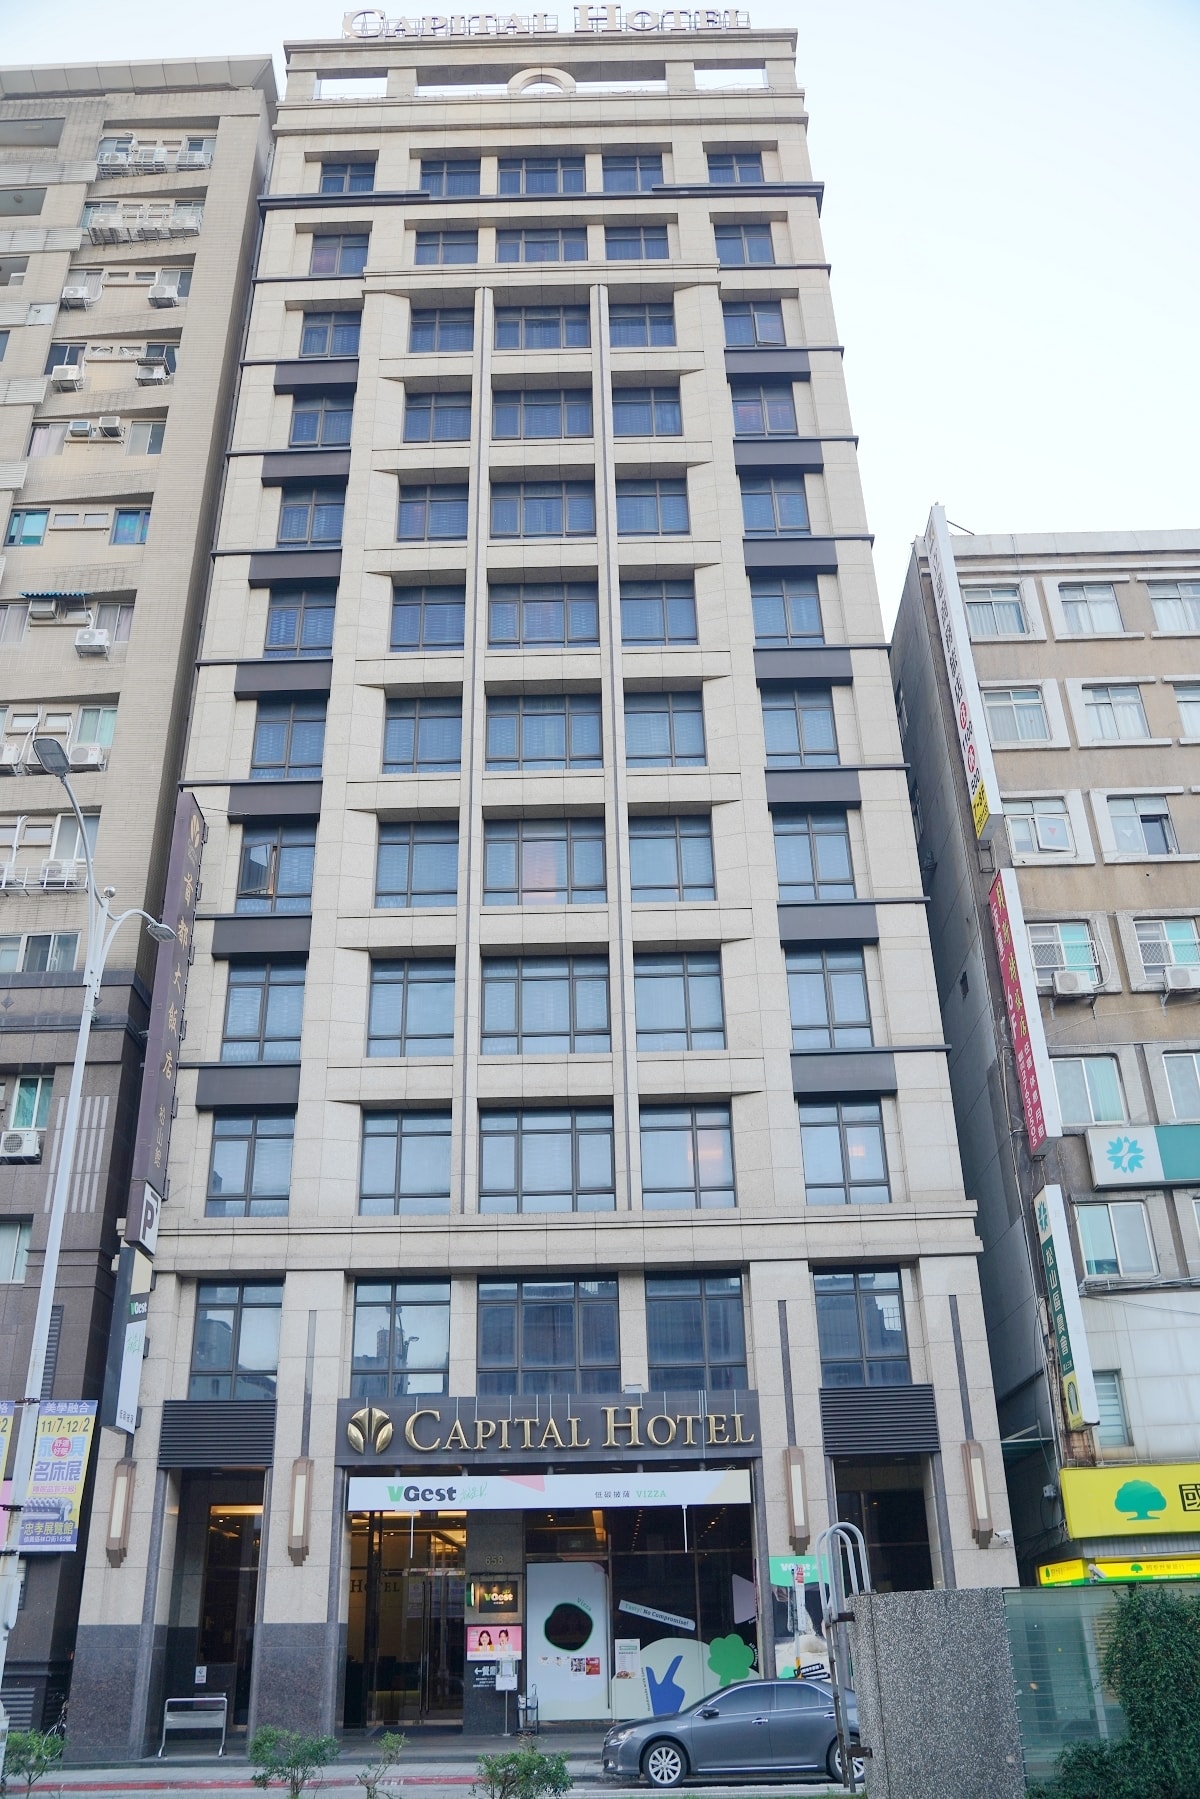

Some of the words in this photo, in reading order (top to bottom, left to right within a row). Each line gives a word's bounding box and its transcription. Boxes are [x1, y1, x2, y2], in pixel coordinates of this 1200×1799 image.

[342, 9, 558, 38] CAPITAL
[574, 4, 750, 32] HOTEL
[162, 871, 192, 1081] 首都大飯店
[141, 1199, 155, 1244] P
[45, 1402, 90, 1414] 美學融合
[405, 1409, 591, 1451] CAPITAL
[600, 1405, 755, 1447] HOTEL
[34, 1461, 82, 1482] 名床展
[387, 1485, 457, 1502] VGest
[636, 1489, 667, 1498] VIZZA
[24, 1521, 74, 1536] 忠孝展覽館
[485, 1556, 504, 1566] 658
[350, 1579, 400, 1593] HEL
